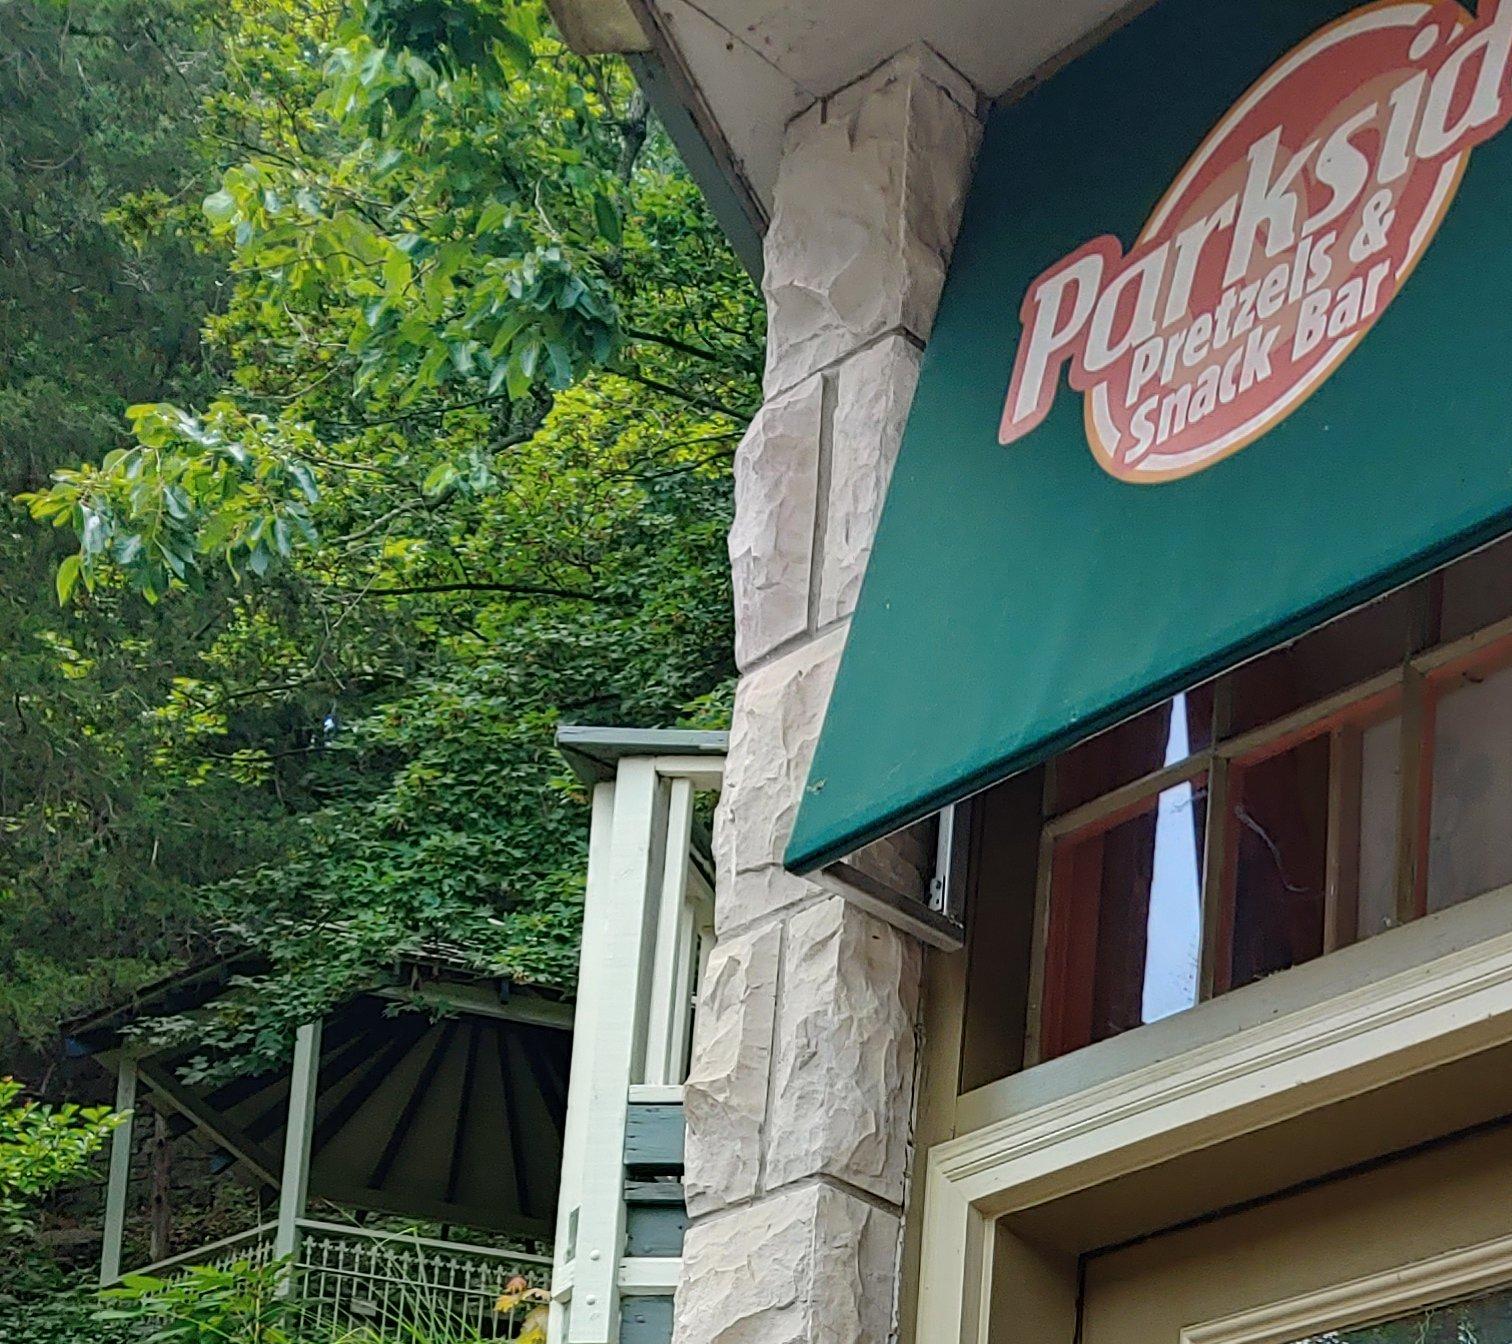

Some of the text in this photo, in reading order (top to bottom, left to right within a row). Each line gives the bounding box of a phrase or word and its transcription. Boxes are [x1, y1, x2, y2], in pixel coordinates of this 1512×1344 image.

[1124, 257, 1391, 464] Snack Bar
[1125, 189, 1396, 408] Pretzels &
